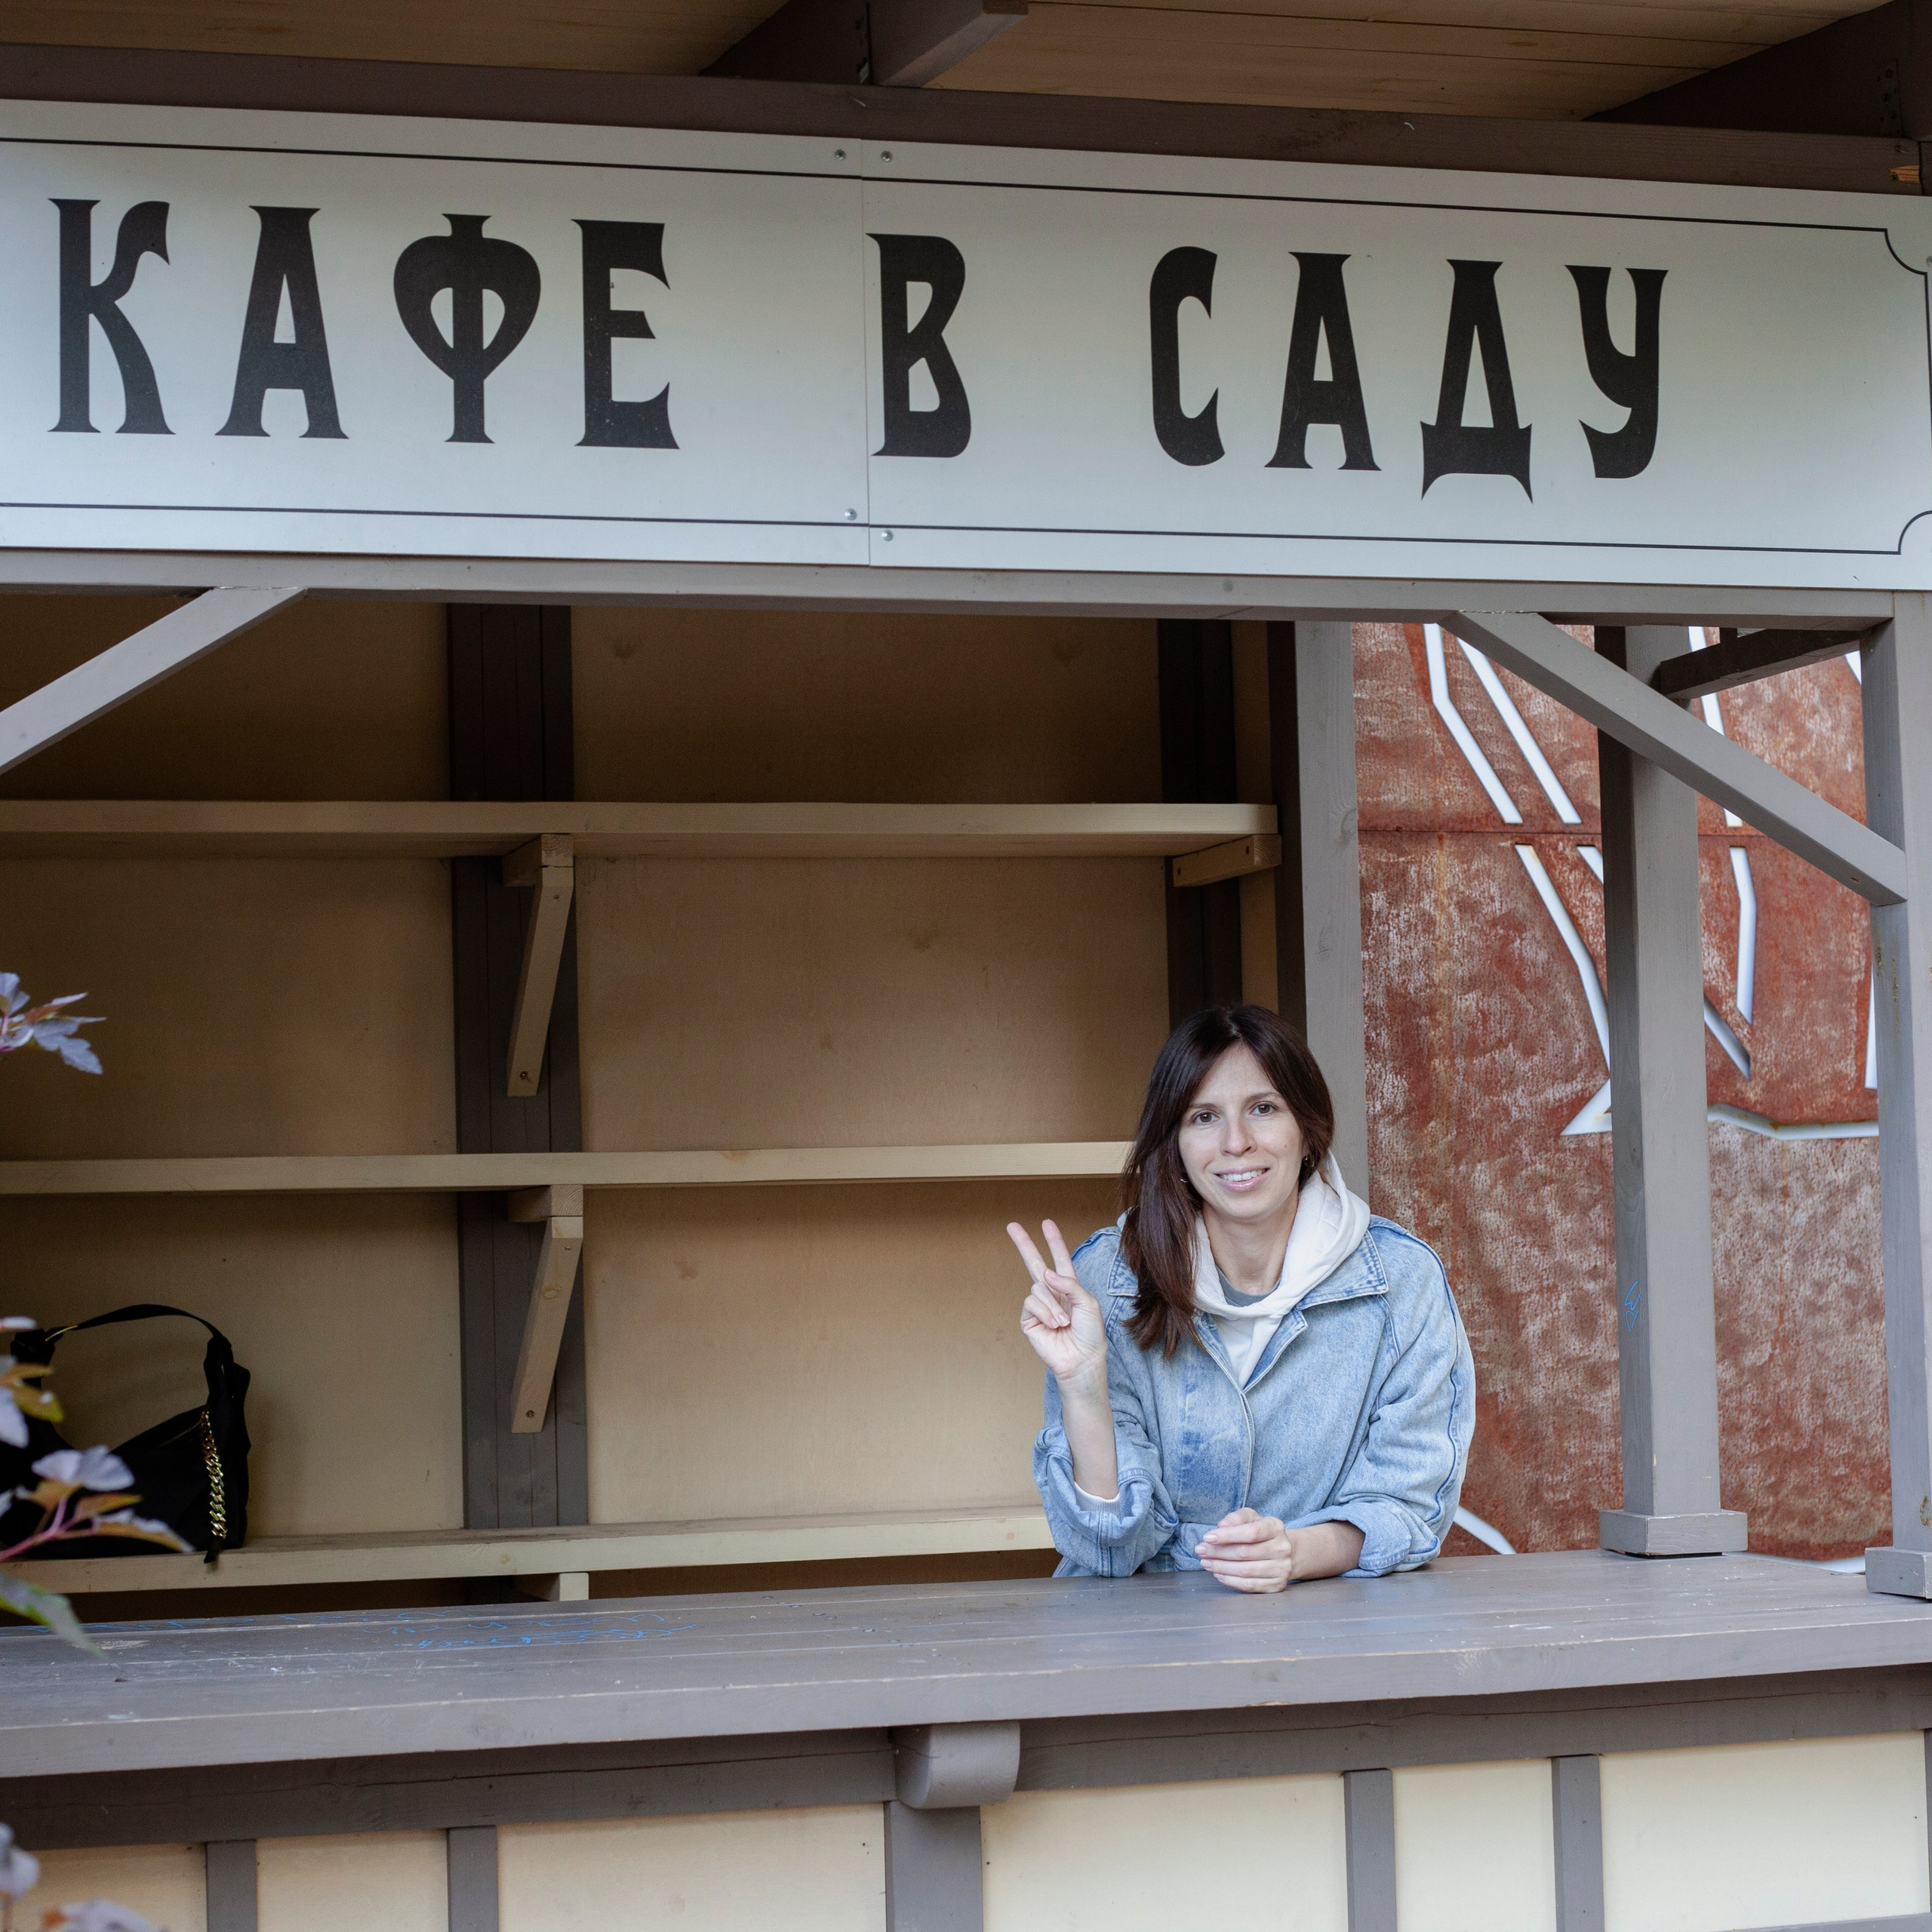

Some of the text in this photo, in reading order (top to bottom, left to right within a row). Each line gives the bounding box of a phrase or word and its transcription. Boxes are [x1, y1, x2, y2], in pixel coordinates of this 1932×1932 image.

[48, 198, 1669, 502] КАФЕ В САДУ
